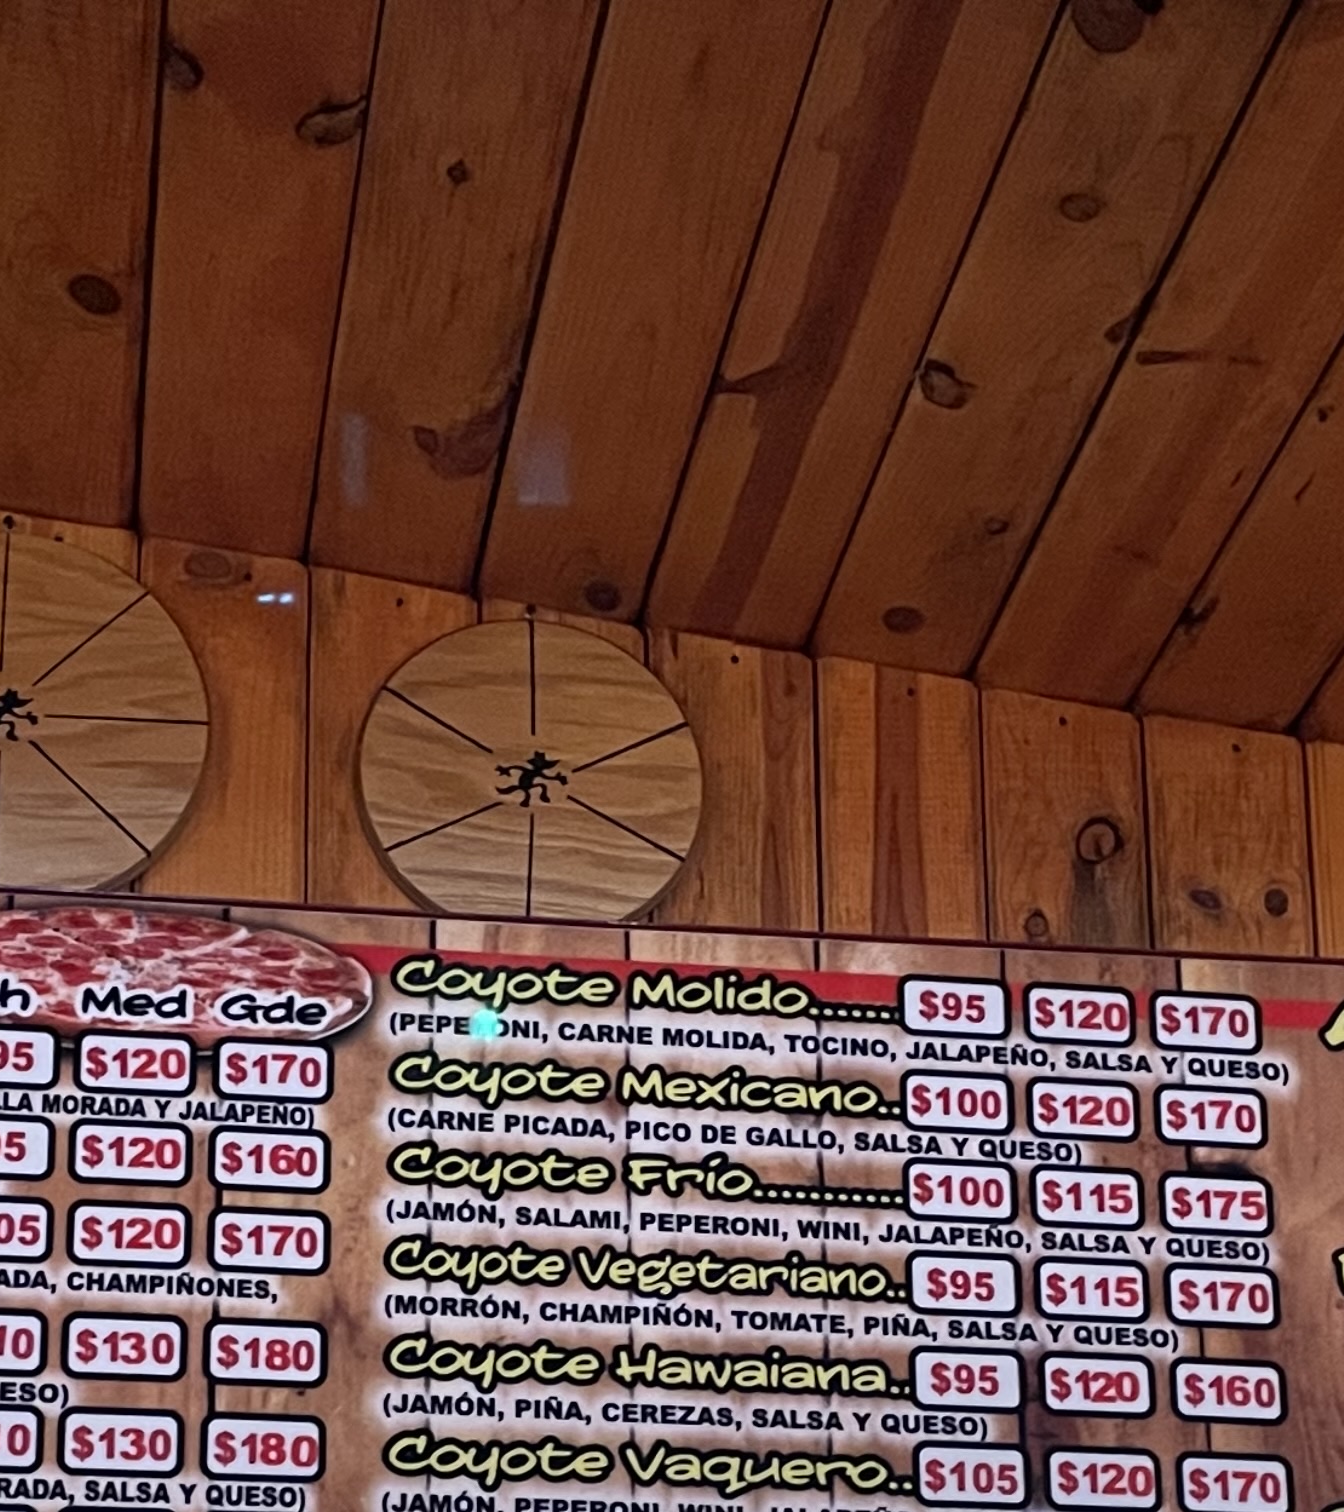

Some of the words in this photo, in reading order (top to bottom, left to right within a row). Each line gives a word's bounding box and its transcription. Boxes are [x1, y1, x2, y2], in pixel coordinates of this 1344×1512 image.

[79, 986, 190, 1019] Med
[219, 994, 328, 1026] Gde
[394, 957, 616, 1012] Coyote
[920, 991, 984, 1021] $95
[1036, 998, 1130, 1032] $120
[1161, 1004, 1248, 1037] $170
[87, 1048, 187, 1080] $120
[227, 1053, 321, 1087] $170
[41, 1093, 147, 1118] MORADA
[154, 1099, 172, 1119] Y
[83, 1135, 183, 1169] $120
[222, 1142, 317, 1176] $160
[388, 1107, 495, 1133] (CARNE
[504, 1114, 615, 1143] PICADA,
[625, 1120, 691, 1142] PICO
[701, 1124, 737, 1145] DE
[746, 1126, 845, 1155] GALLO,
[854, 1132, 943, 1155] SALSA
[951, 1137, 969, 1157] Y
[977, 1138, 1082, 1167] QUESO)
[391, 1143, 611, 1193] Coyote
[913, 1173, 1004, 1207] $100
[1042, 1180, 1133, 1214] $115
[1172, 1187, 1266, 1221] $175
[76, 1329, 174, 1365] $130
[218, 1335, 315, 1371] $180
[388, 1336, 600, 1387] Coyote
[931, 1363, 998, 1395] $95
[1051, 1369, 1140, 1404] $120
[1184, 1375, 1275, 1407] $160
[383, 1391, 505, 1422] (JAMÓN,
[515, 1396, 592, 1425] PIÑA,
[601, 1402, 742, 1432] CEREZAS,
[752, 1408, 844, 1431] SALSA
[852, 1412, 872, 1432] Y
[880, 1413, 988, 1443] QUESO)
